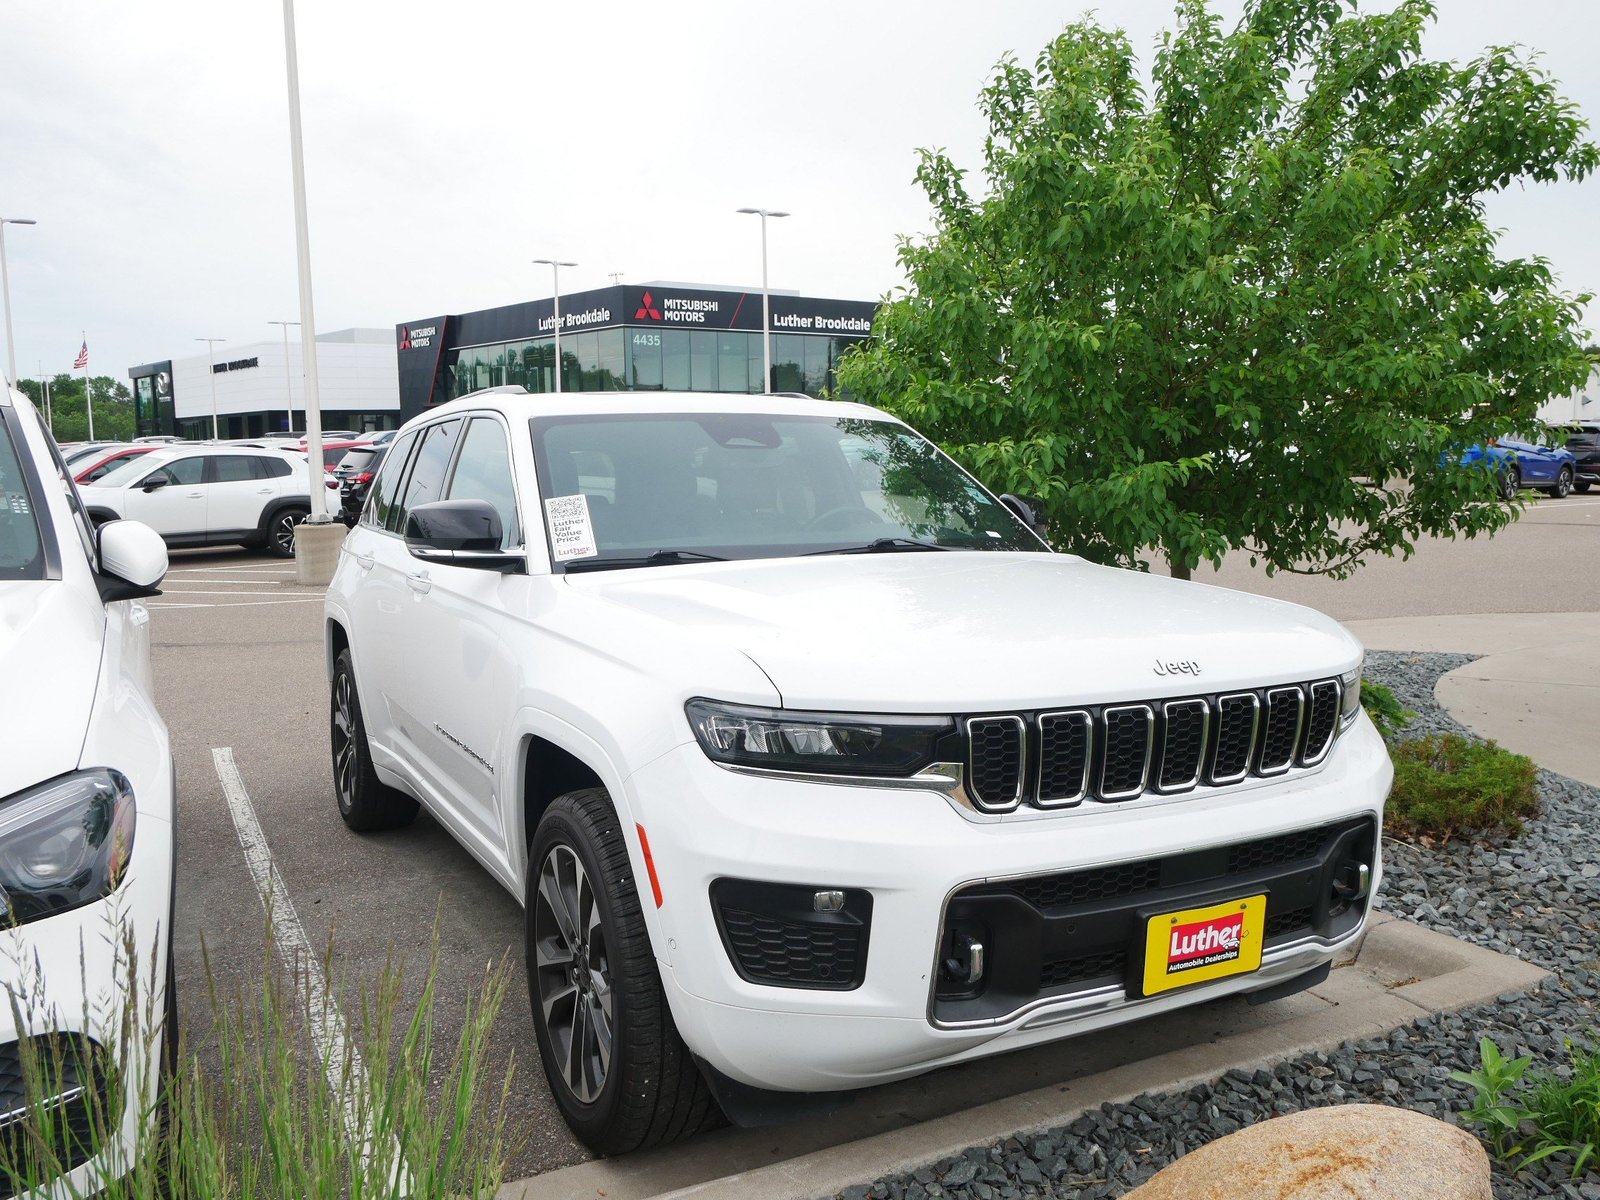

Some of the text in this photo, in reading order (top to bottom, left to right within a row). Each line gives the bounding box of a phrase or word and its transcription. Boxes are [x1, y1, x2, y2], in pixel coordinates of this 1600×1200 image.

[663, 299, 718, 312] MITSUBISHI
[566, 308, 610, 326] Brookdale
[664, 311, 705, 322] MOTORS
[773, 314, 871, 331] Luther Brookdale
[633, 334, 660, 346] 4435
[553, 519, 585, 527] Luther
[1153, 659, 1202, 676] Jeep
[1170, 923, 1241, 956] Luther
[1168, 950, 1238, 971] Automobile Dealerships
